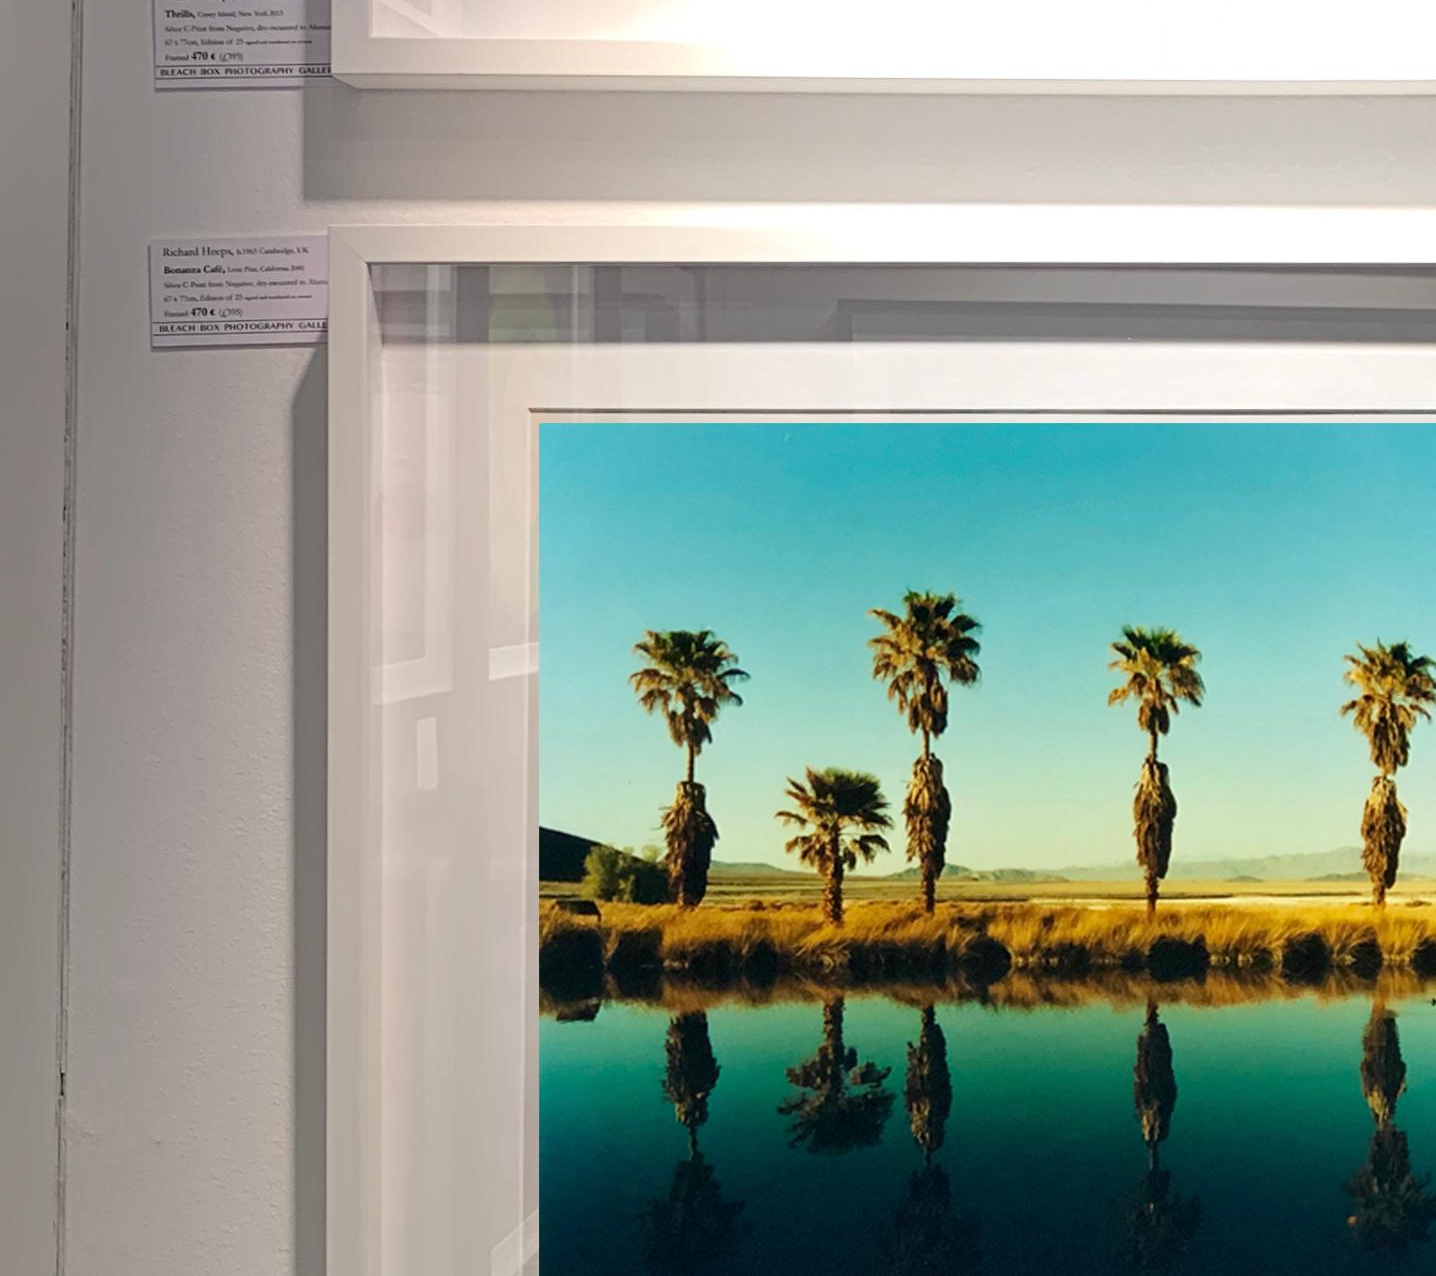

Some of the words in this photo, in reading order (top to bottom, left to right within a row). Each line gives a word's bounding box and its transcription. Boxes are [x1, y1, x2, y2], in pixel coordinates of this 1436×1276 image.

[165, 9, 195, 18] Thrills,
[191, 51, 208, 61] 470
[160, 67, 196, 76] BLEACH
[200, 68, 221, 76] BOX
[224, 66, 293, 76] PHOTOGRAPHY
[163, 246, 199, 257] Richard
[202, 245, 234, 259] Heeps,
[164, 265, 201, 275] Bonanza
[191, 307, 208, 317] 470
[160, 324, 196, 333] BLEACH
[200, 323, 220, 331] BOX
[224, 321, 293, 331] PHOTOGRAPHY
